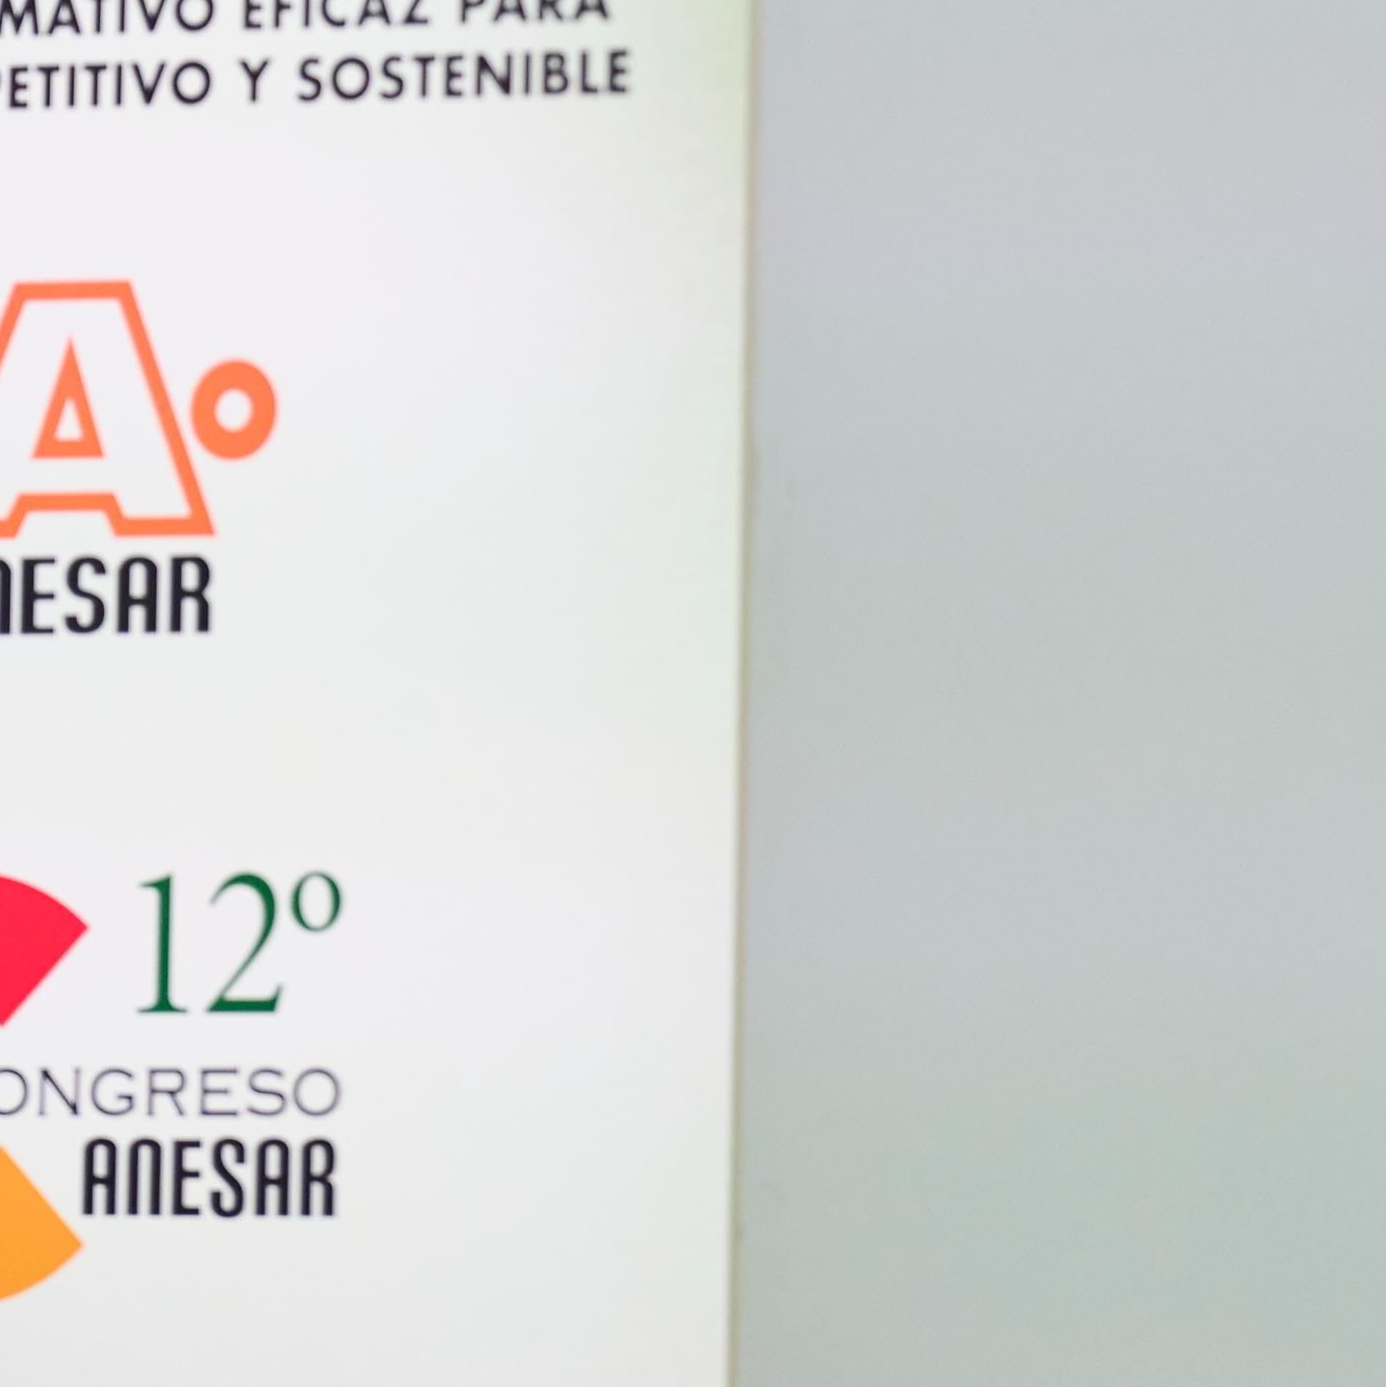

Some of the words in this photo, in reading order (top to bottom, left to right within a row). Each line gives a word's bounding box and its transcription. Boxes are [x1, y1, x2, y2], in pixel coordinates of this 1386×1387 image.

[238, 58, 271, 103] Y
[297, 47, 630, 103] SOSTENIBLE
[81, 1136, 336, 1219] ANESAR
